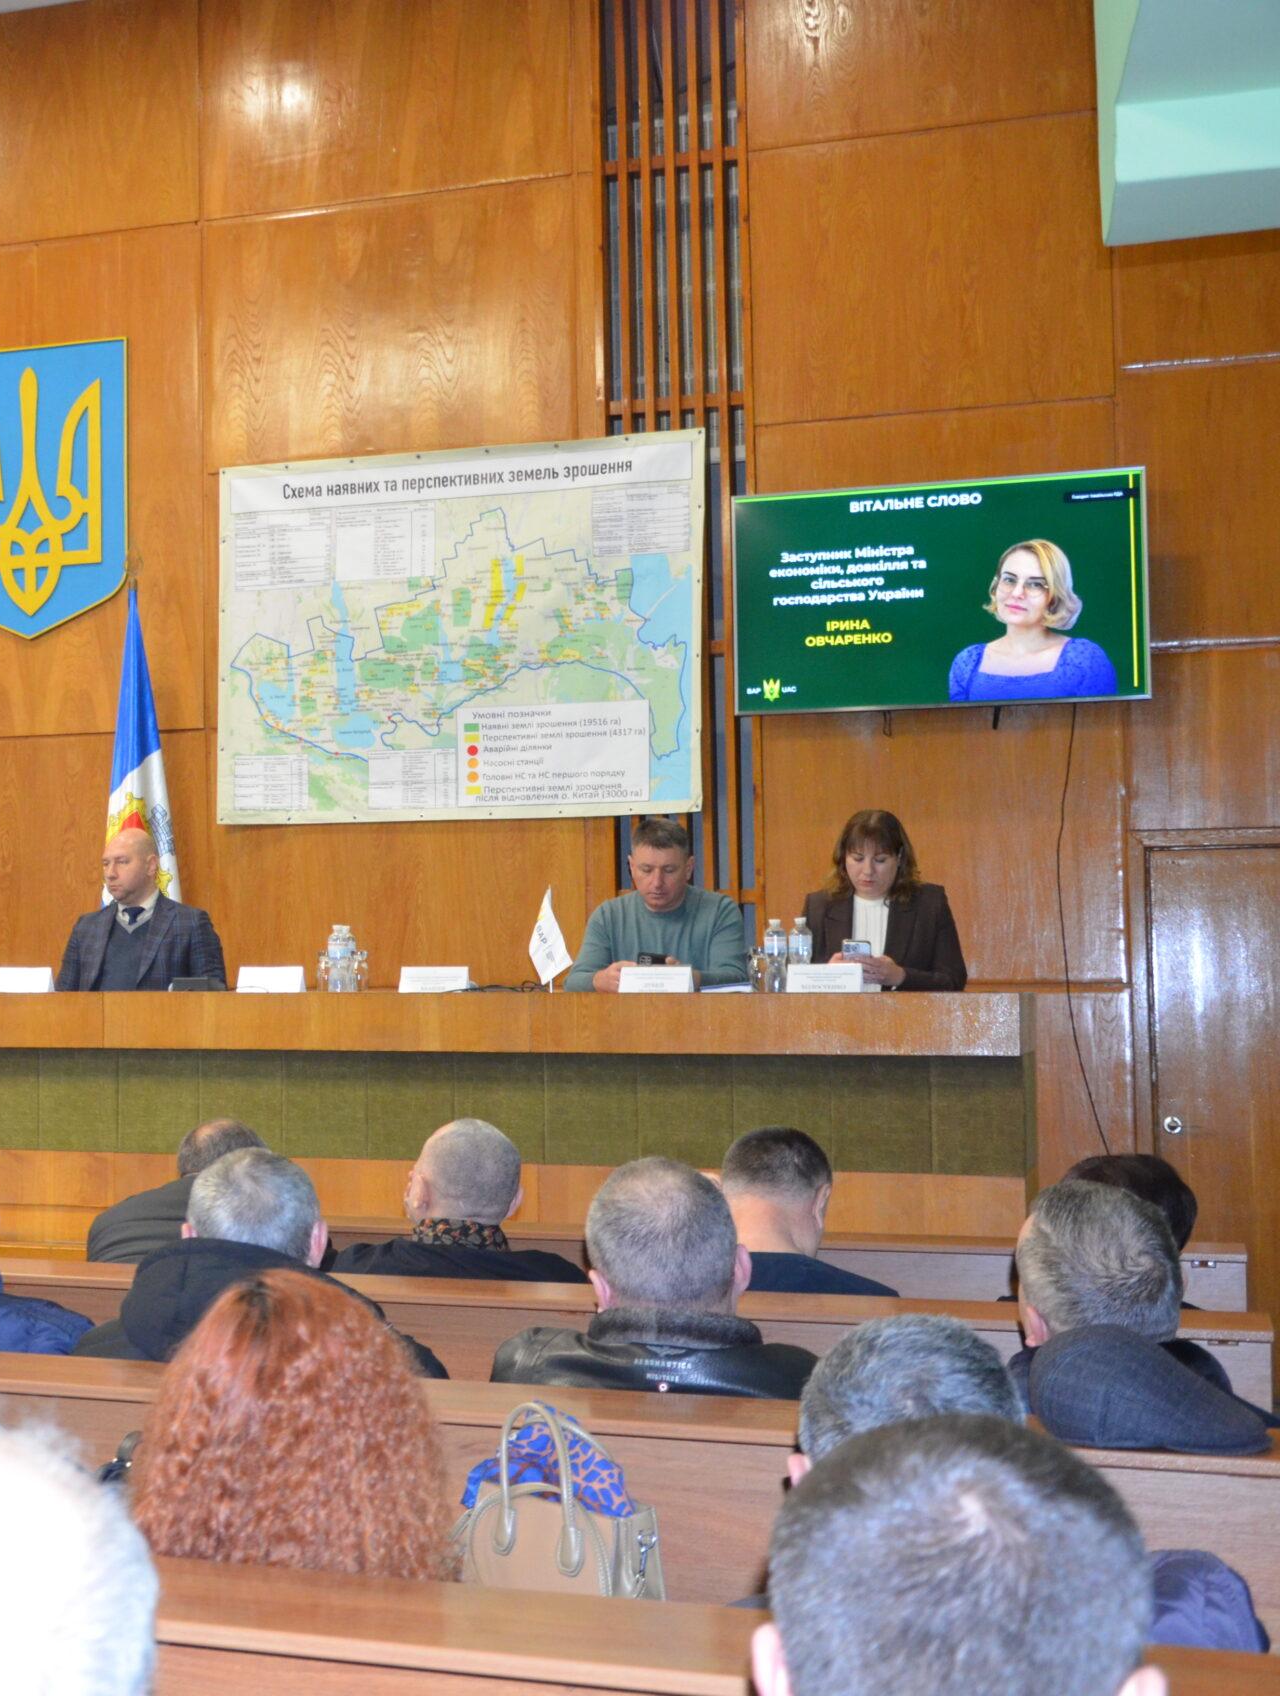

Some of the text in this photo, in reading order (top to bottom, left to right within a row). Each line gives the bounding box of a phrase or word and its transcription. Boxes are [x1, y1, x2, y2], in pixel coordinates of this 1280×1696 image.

[283, 460, 632, 500] Схема наявних та перспективних земель зрошення
[849, 492, 982, 513] ВІТАЛЬНЕ СЛОВО
[780, 545, 915, 564] Заступник Міністра
[769, 559, 927, 578] економіки, довкілля та
[810, 576, 885, 590] сільського
[773, 587, 925, 606] господарства України
[826, 619, 870, 632] ІРИНА
[805, 632, 893, 647] ОВЧАРЕНКО
[472, 710, 551, 720] Умовні позначки
[481, 722, 509, 730] Наявні
[511, 721, 534, 729] землі
[537, 720, 577, 729] зрошення
[482, 733, 538, 742] Перспективні
[541, 731, 563, 739] землі
[566, 730, 607, 739] зрошення
[483, 744, 552, 754] Аварійні ділянки
[483, 757, 544, 767] Насосні станції
[482, 773, 513, 781] Головні
[552, 771, 588, 779] першого
[590, 769, 625, 778] порядку
[483, 783, 621, 795] Перспективні землі зрошення
[475, 794, 499, 802] після
[501, 793, 558, 801] відновлення
[572, 790, 599, 799] Китай
